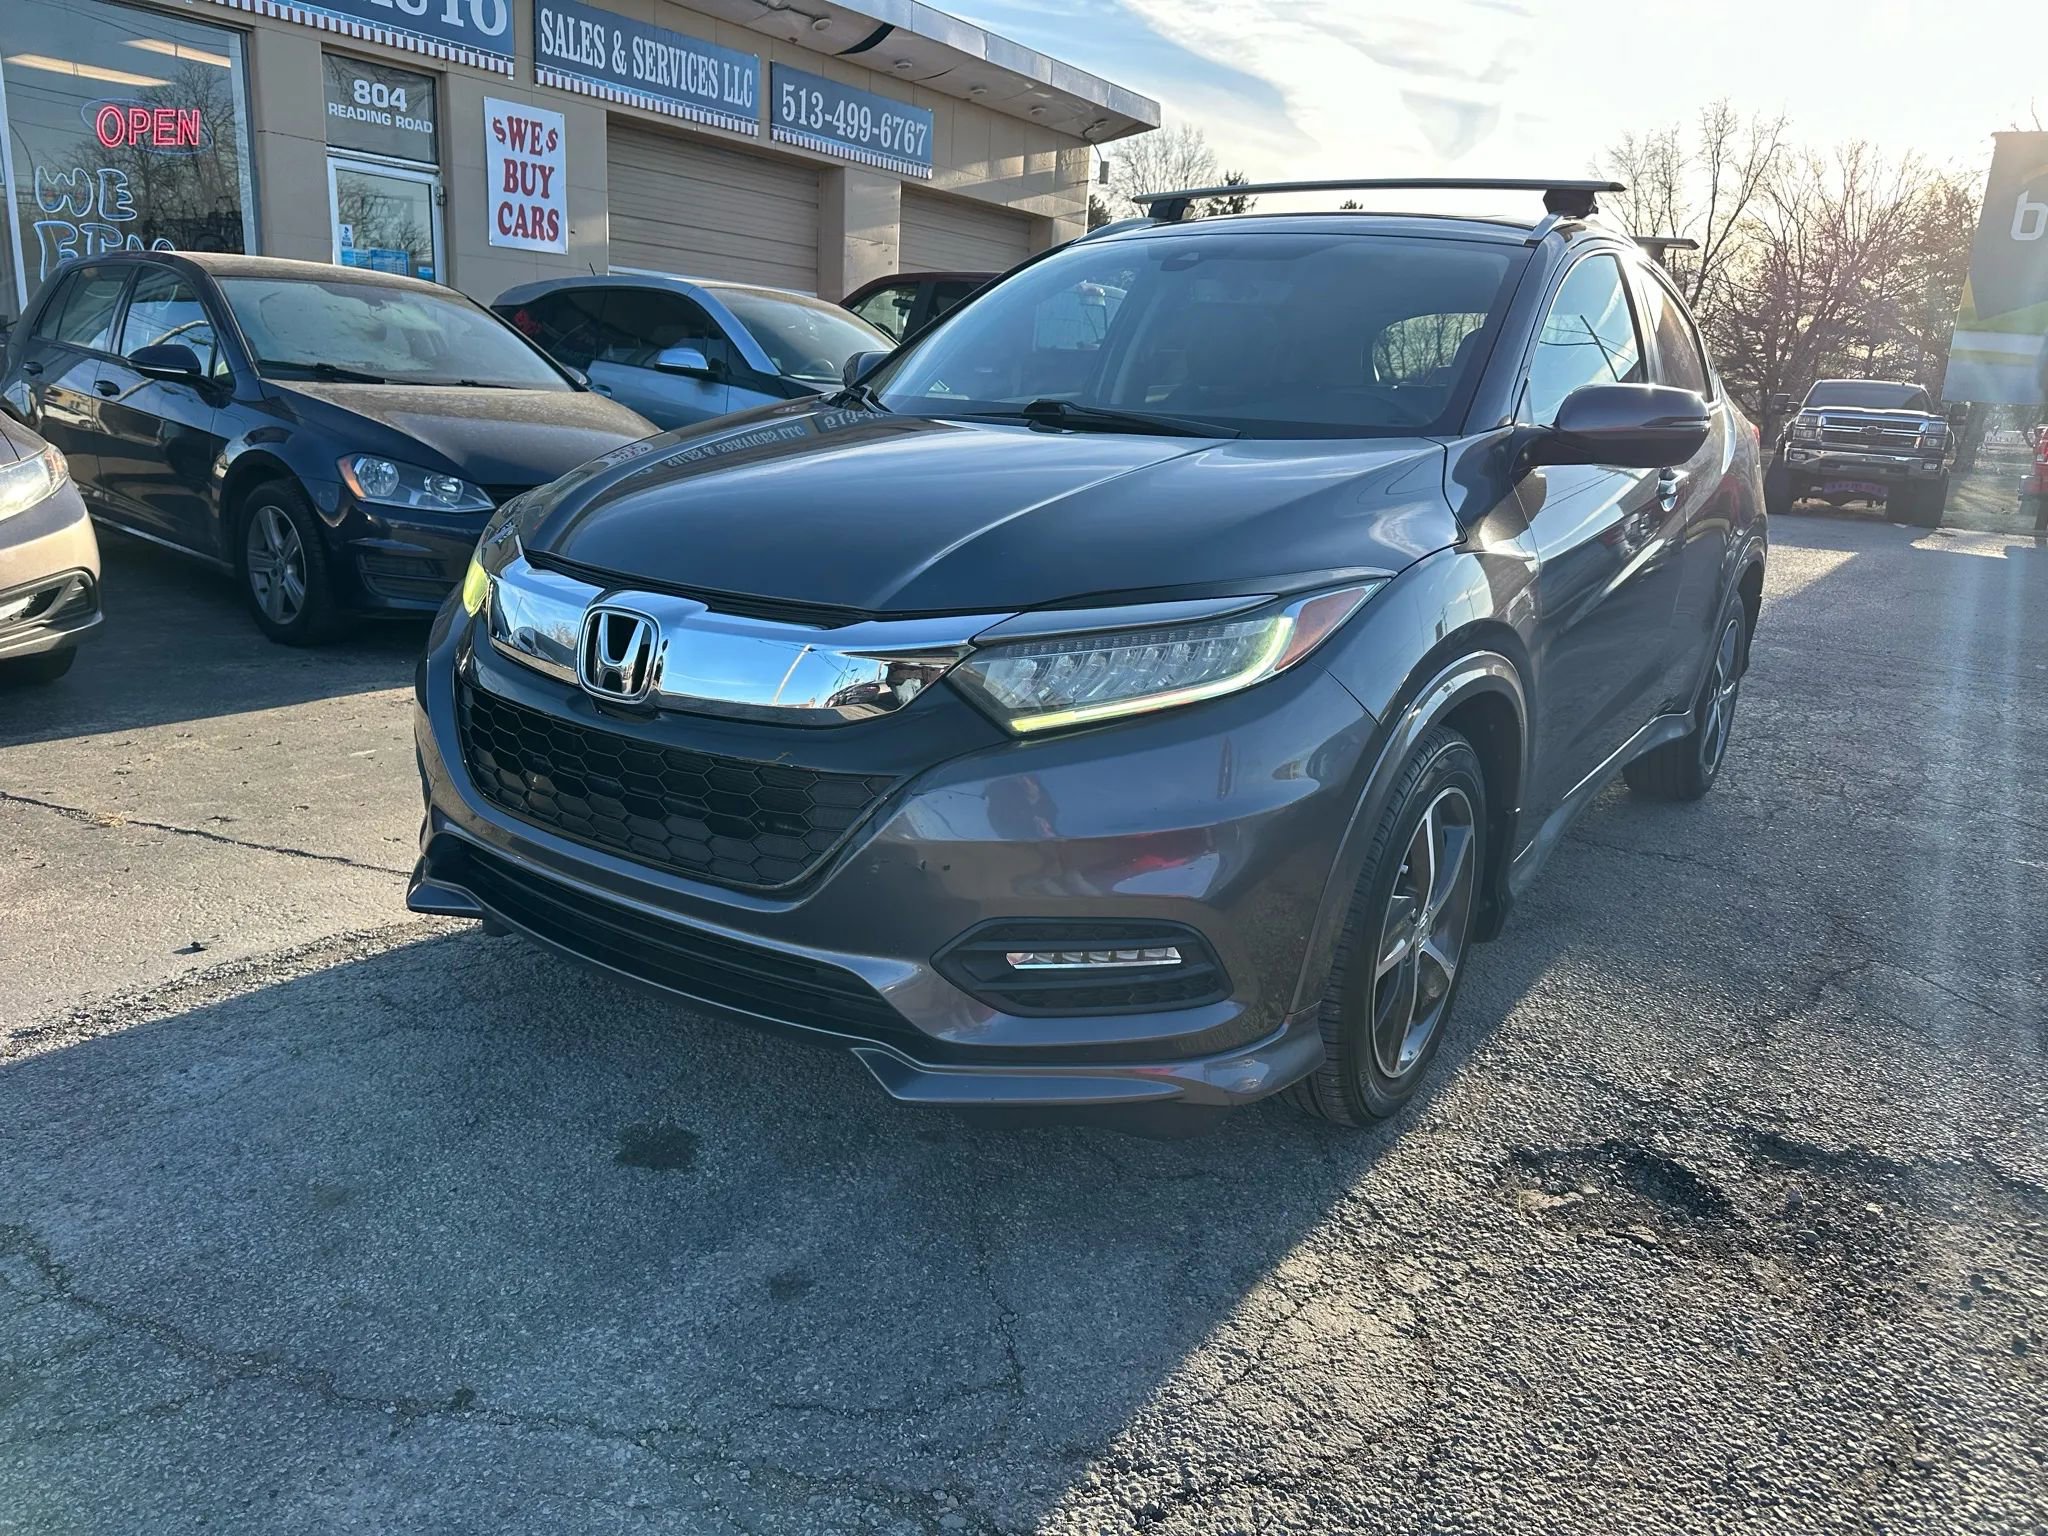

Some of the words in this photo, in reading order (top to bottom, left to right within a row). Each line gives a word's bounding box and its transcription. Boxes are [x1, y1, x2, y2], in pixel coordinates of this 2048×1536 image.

[371, 0, 507, 37] TO
[540, 8, 606, 69] SALES
[612, 30, 627, 75] &
[632, 36, 719, 99] SERVICES
[723, 62, 753, 108] LLC
[353, 79, 408, 112] 804
[96, 105, 201, 148] OPEN
[328, 102, 392, 126] READING
[395, 115, 433, 133] ROAD
[782, 82, 928, 156] 513-499-6767
[34, 165, 138, 221] WE
[503, 158, 555, 199] BUY
[497, 201, 560, 241] CARS
